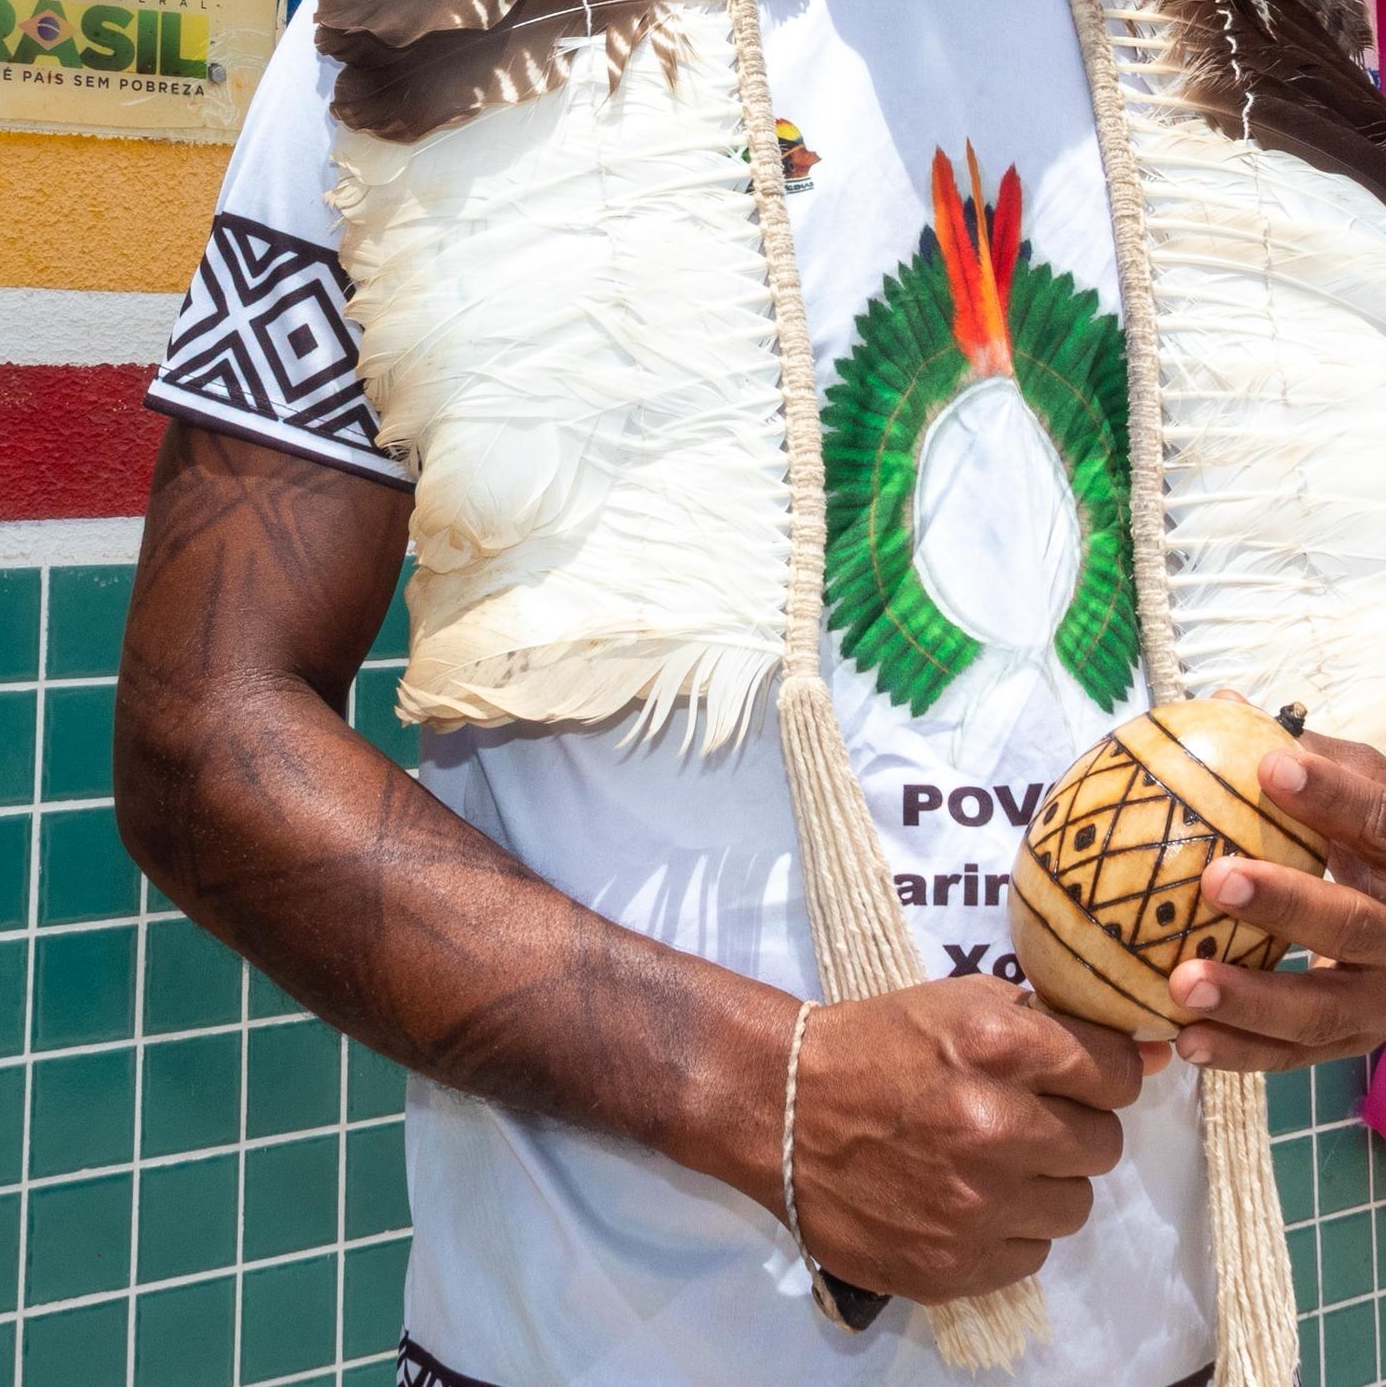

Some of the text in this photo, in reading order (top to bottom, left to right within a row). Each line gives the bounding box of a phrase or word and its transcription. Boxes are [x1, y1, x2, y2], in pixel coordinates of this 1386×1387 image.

[3, 66, 13, 81] É
[22, 69, 64, 86] PAÍS
[73, 74, 110, 90] SEM
[119, 78, 206, 97] POBREZA
[902, 781, 1056, 828] POV
[942, 943, 1029, 985] Xo
